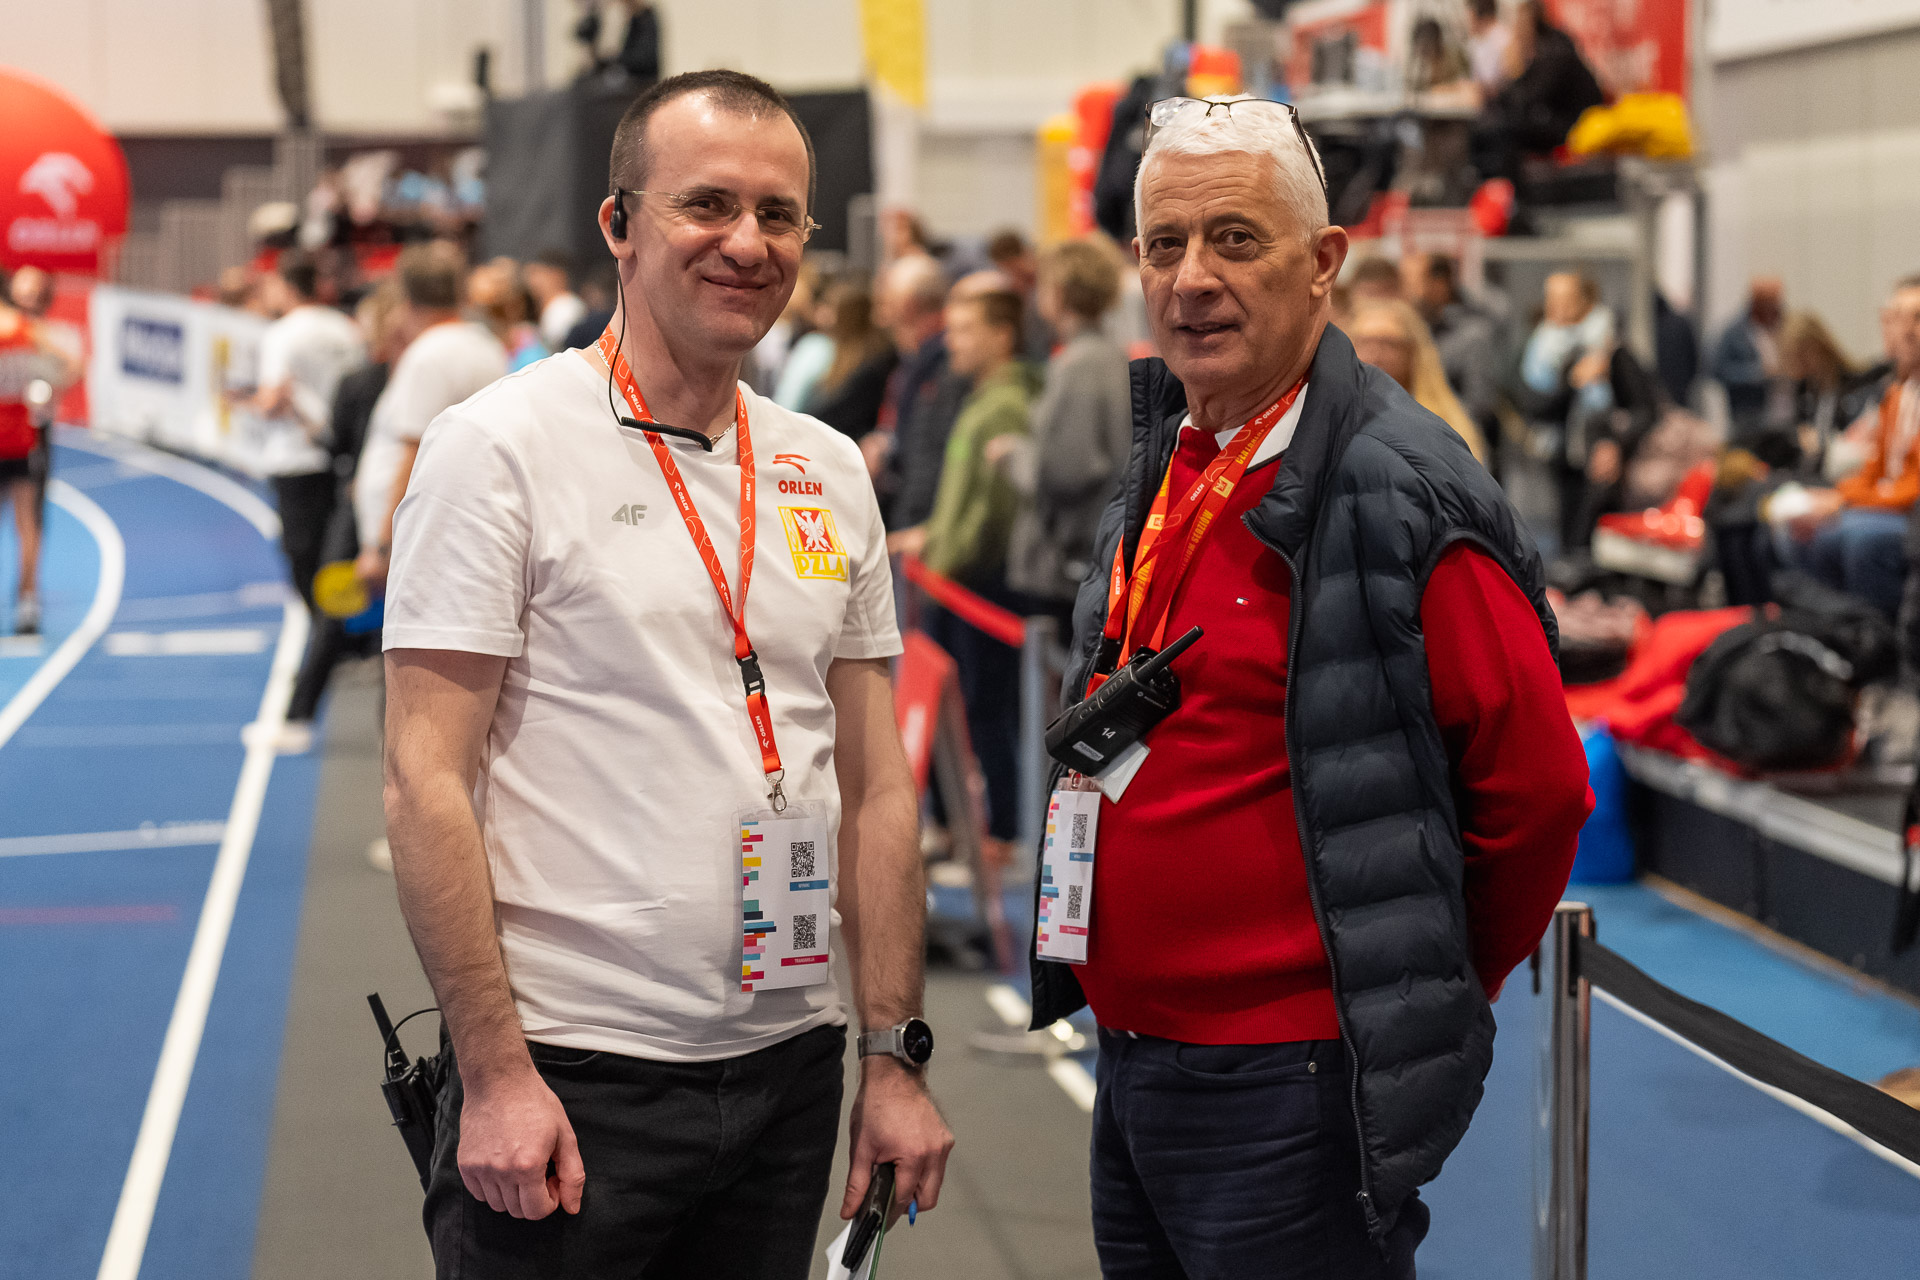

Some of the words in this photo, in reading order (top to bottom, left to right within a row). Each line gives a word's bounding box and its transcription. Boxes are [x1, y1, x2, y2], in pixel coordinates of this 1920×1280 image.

[631, 394, 643, 413] ORLEN
[1262, 403, 1279, 419] ORLEN
[778, 480, 822, 496] ORLEN
[1190, 483, 1205, 501] ORLEN
[678, 492, 690, 511] ORLEN
[611, 503, 647, 526] 4F
[795, 555, 845, 577] PZLA
[755, 716, 766, 736] ORLEN
[1101, 727, 1116, 740] 14
